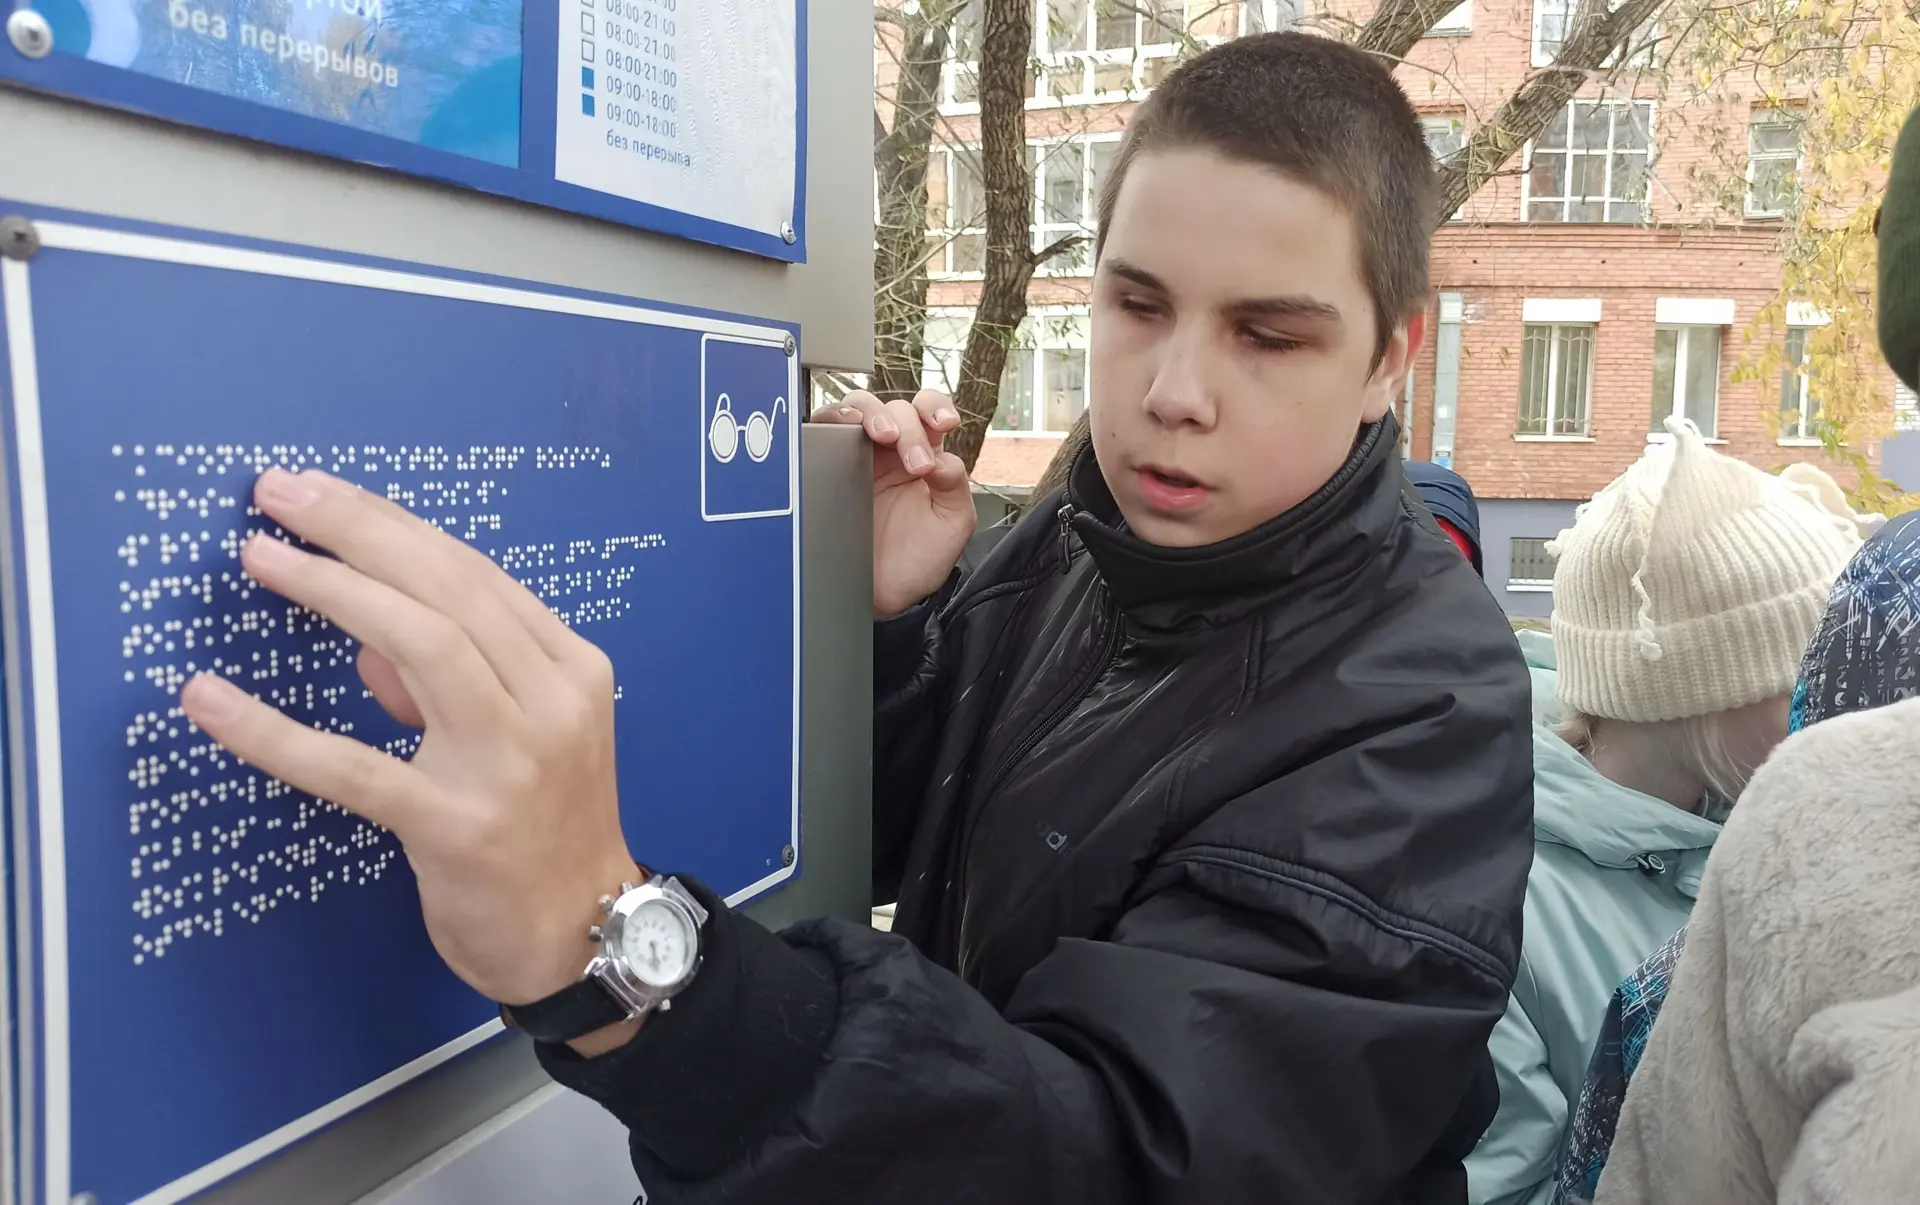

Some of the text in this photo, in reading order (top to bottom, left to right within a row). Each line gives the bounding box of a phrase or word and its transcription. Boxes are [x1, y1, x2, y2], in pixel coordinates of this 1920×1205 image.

[240, 22, 399, 88] перерывов
[606, 21, 676, 62] 08:00-21:00
[606, 48, 677, 88] 08:00-21:00
[606, 75, 676, 113] 09:00-18:00
[606, 102, 676, 138] 09:00-18:00
[606, 128, 691, 167] без перерыва
